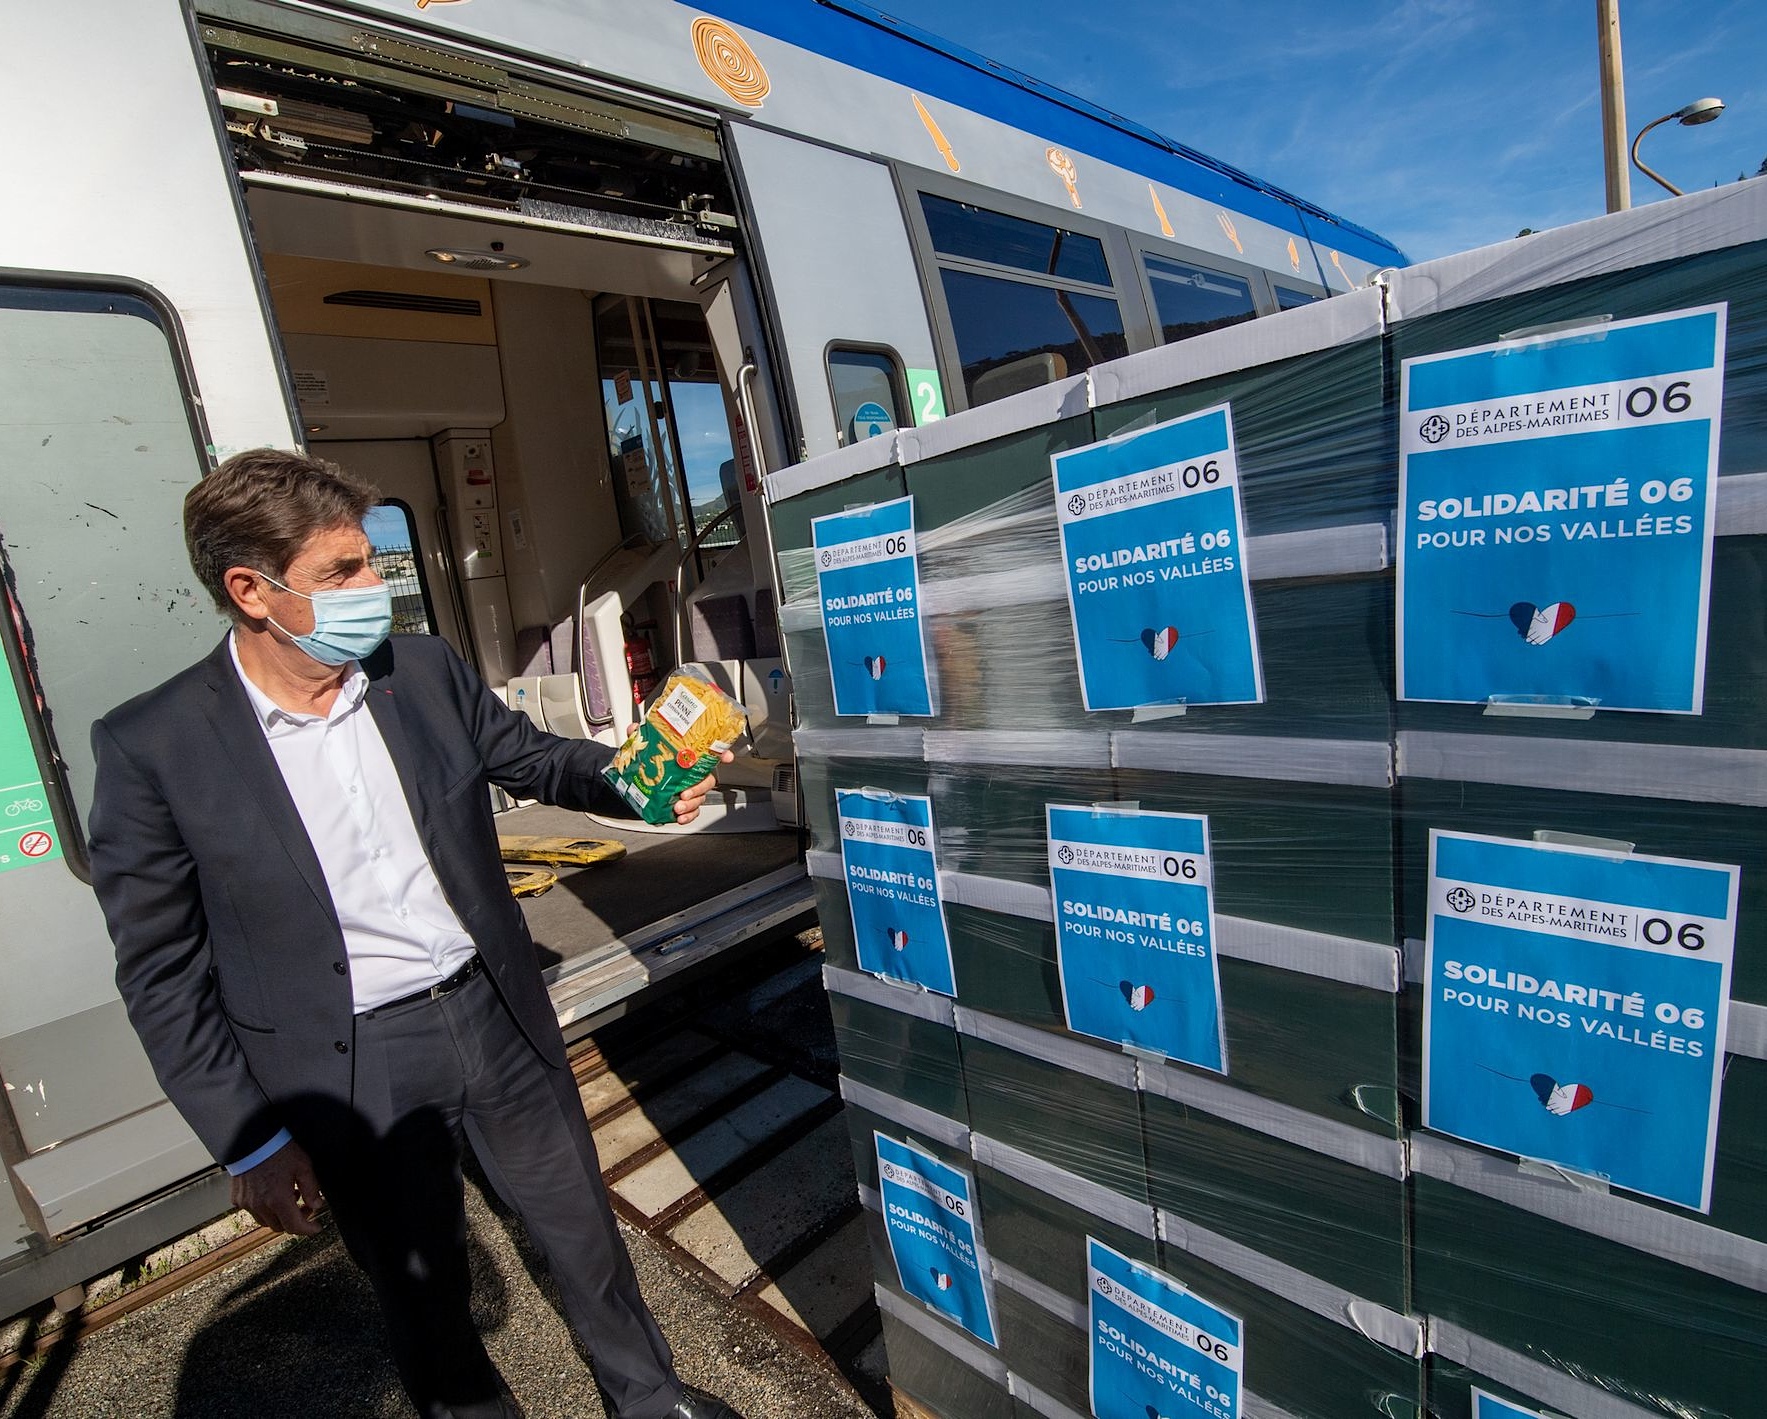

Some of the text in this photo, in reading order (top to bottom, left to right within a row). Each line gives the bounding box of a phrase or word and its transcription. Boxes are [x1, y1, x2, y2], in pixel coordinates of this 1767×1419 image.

[918, 382, 940, 422] 2
[1456, 381, 1692, 425] DÉPARTEMENT 06
[1456, 409, 1609, 438] DES ALPES-MARITIMES
[1087, 460, 1220, 502] DÉPARTEMENT 06
[1089, 484, 1175, 511] DES ALPES-MARITIMES
[1418, 477, 1694, 521] SOLIDARITÉ 06
[886, 536, 906, 555] 06
[1417, 513, 1692, 550] POUR NOS VALLÉES
[1075, 529, 1231, 574] SOLIDARITÉ 06
[1078, 556, 1234, 594] POUR NOS VALLÉES
[826, 587, 912, 611] SOLIDARITÉ 06
[828, 606, 914, 628] POUR NOS VALLÉES
[674, 698, 692, 718] PENNE
[908, 829, 926, 846] 06
[850, 864, 934, 891] SOLIDARITÉ 06
[1076, 848, 1197, 879] DÉPARTEMENT 06
[1077, 858, 1157, 874] DES ALPES-MARITIMES
[852, 882, 936, 908] POUR NOS VALLÉES
[1062, 900, 1204, 936] SOLIDARITÉ 06
[1482, 892, 1706, 950] DÉPARTEMENT 06
[1482, 906, 1627, 938] DES ALPES-MARITIMES
[1065, 922, 1206, 958] POUR NOS VALLÉES
[1442, 960, 1706, 1031] SOLIDARITÉ 06
[1443, 988, 1704, 1058] POUR NOS VALLÉES
[945, 1195, 964, 1216] 06
[888, 1202, 973, 1255] SOLIDARITÉ 06
[890, 1218, 976, 1270] POUR NOS VALLÉES
[1114, 1294, 1127, 1306] DES
[1098, 1336, 1134, 1364] POUR
[1136, 1362, 1164, 1385] NOS
[1098, 1320, 1231, 1408] SOLIDARITÉ 06
[1196, 1334, 1228, 1362] 06
